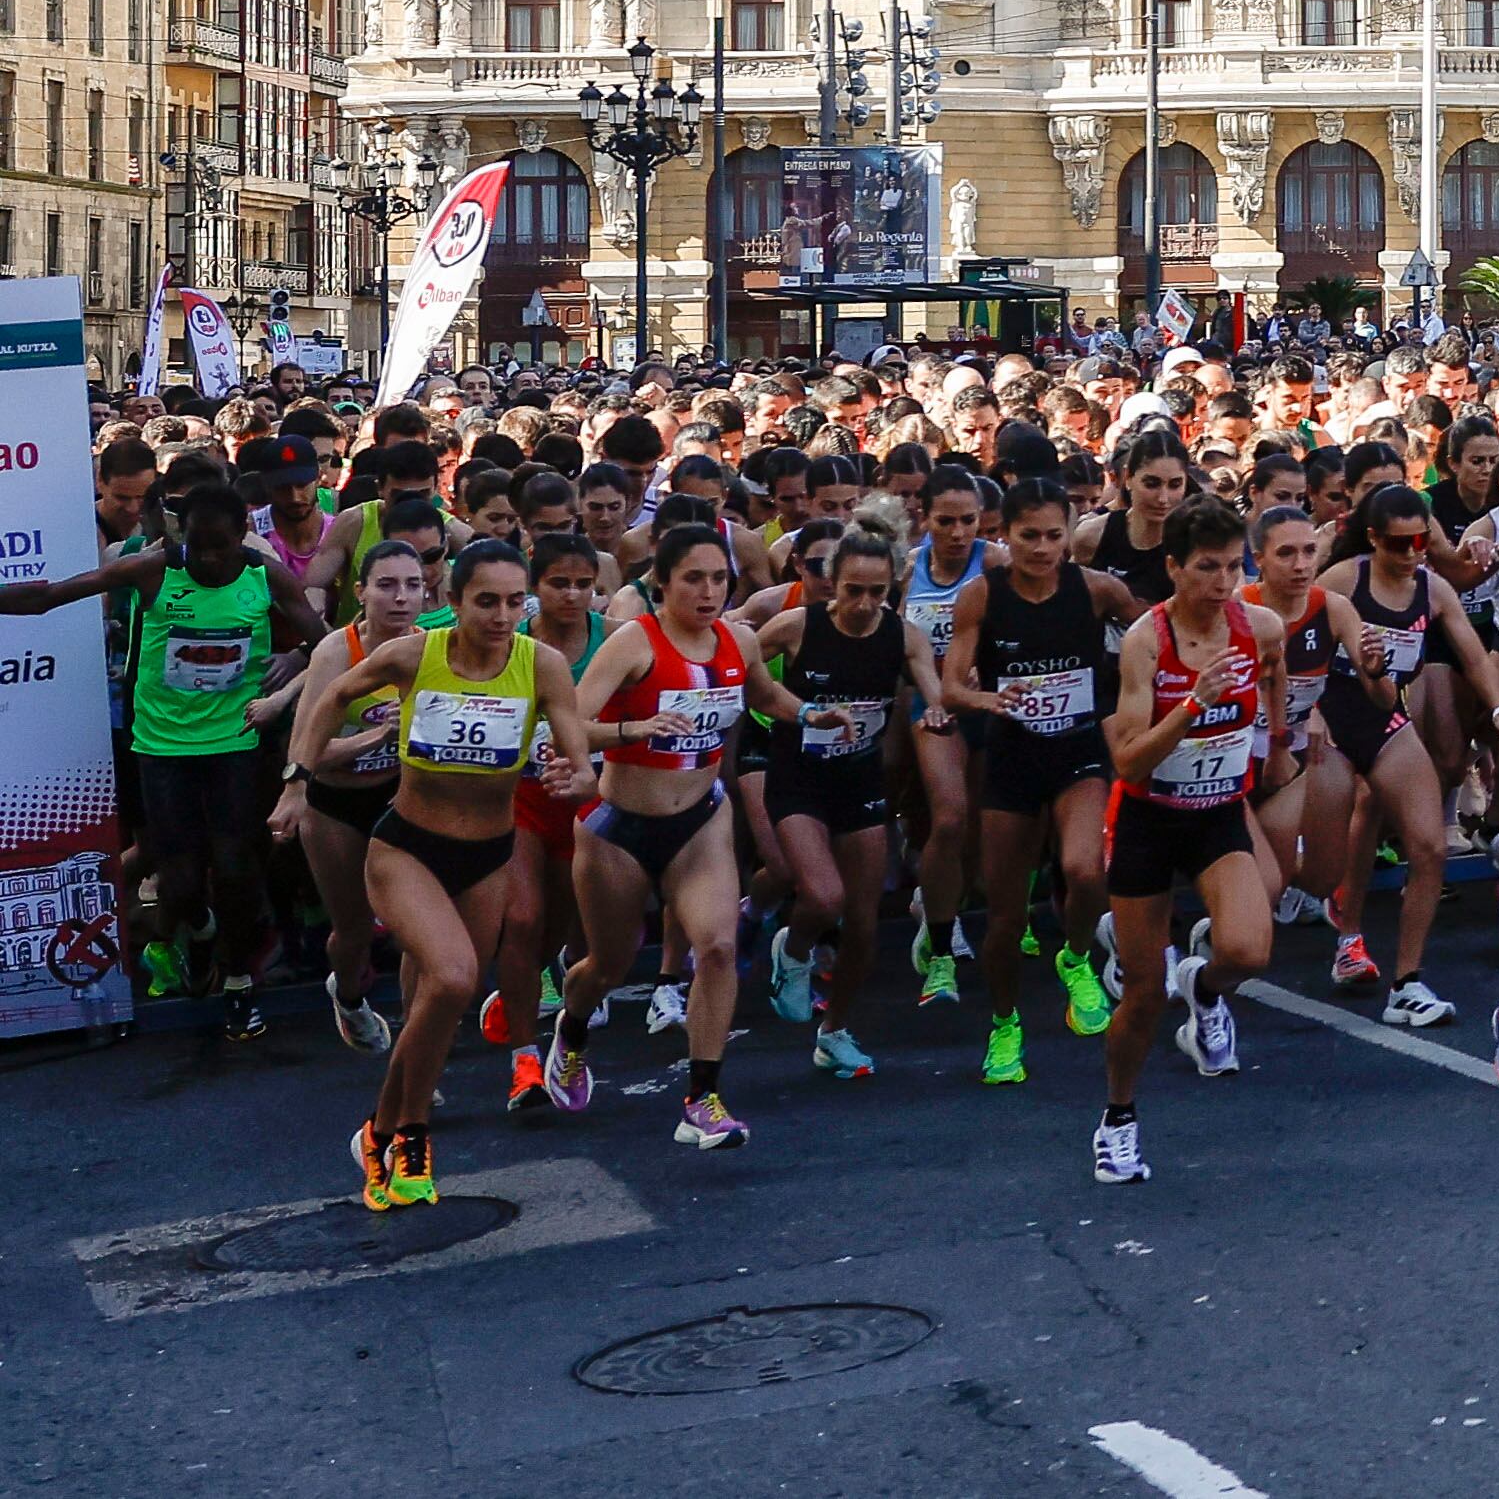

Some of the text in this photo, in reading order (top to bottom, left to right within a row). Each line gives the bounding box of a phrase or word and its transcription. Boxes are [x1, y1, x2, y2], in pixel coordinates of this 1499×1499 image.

[784, 161, 851, 171] ENTREGA EN MANO
[858, 231, 923, 245] La Regenta
[17, 342, 58, 354] KUTXA
[0, 530, 43, 558] DI
[0, 650, 56, 685] aia
[1007, 656, 1080, 674] OYSHO
[1024, 693, 1070, 718] 857
[1204, 704, 1239, 725] BM
[448, 720, 487, 745] 36
[670, 731, 721, 752] Joma
[431, 745, 498, 765] Joma
[1192, 755, 1225, 780] 17
[1172, 778, 1236, 797] Joma
